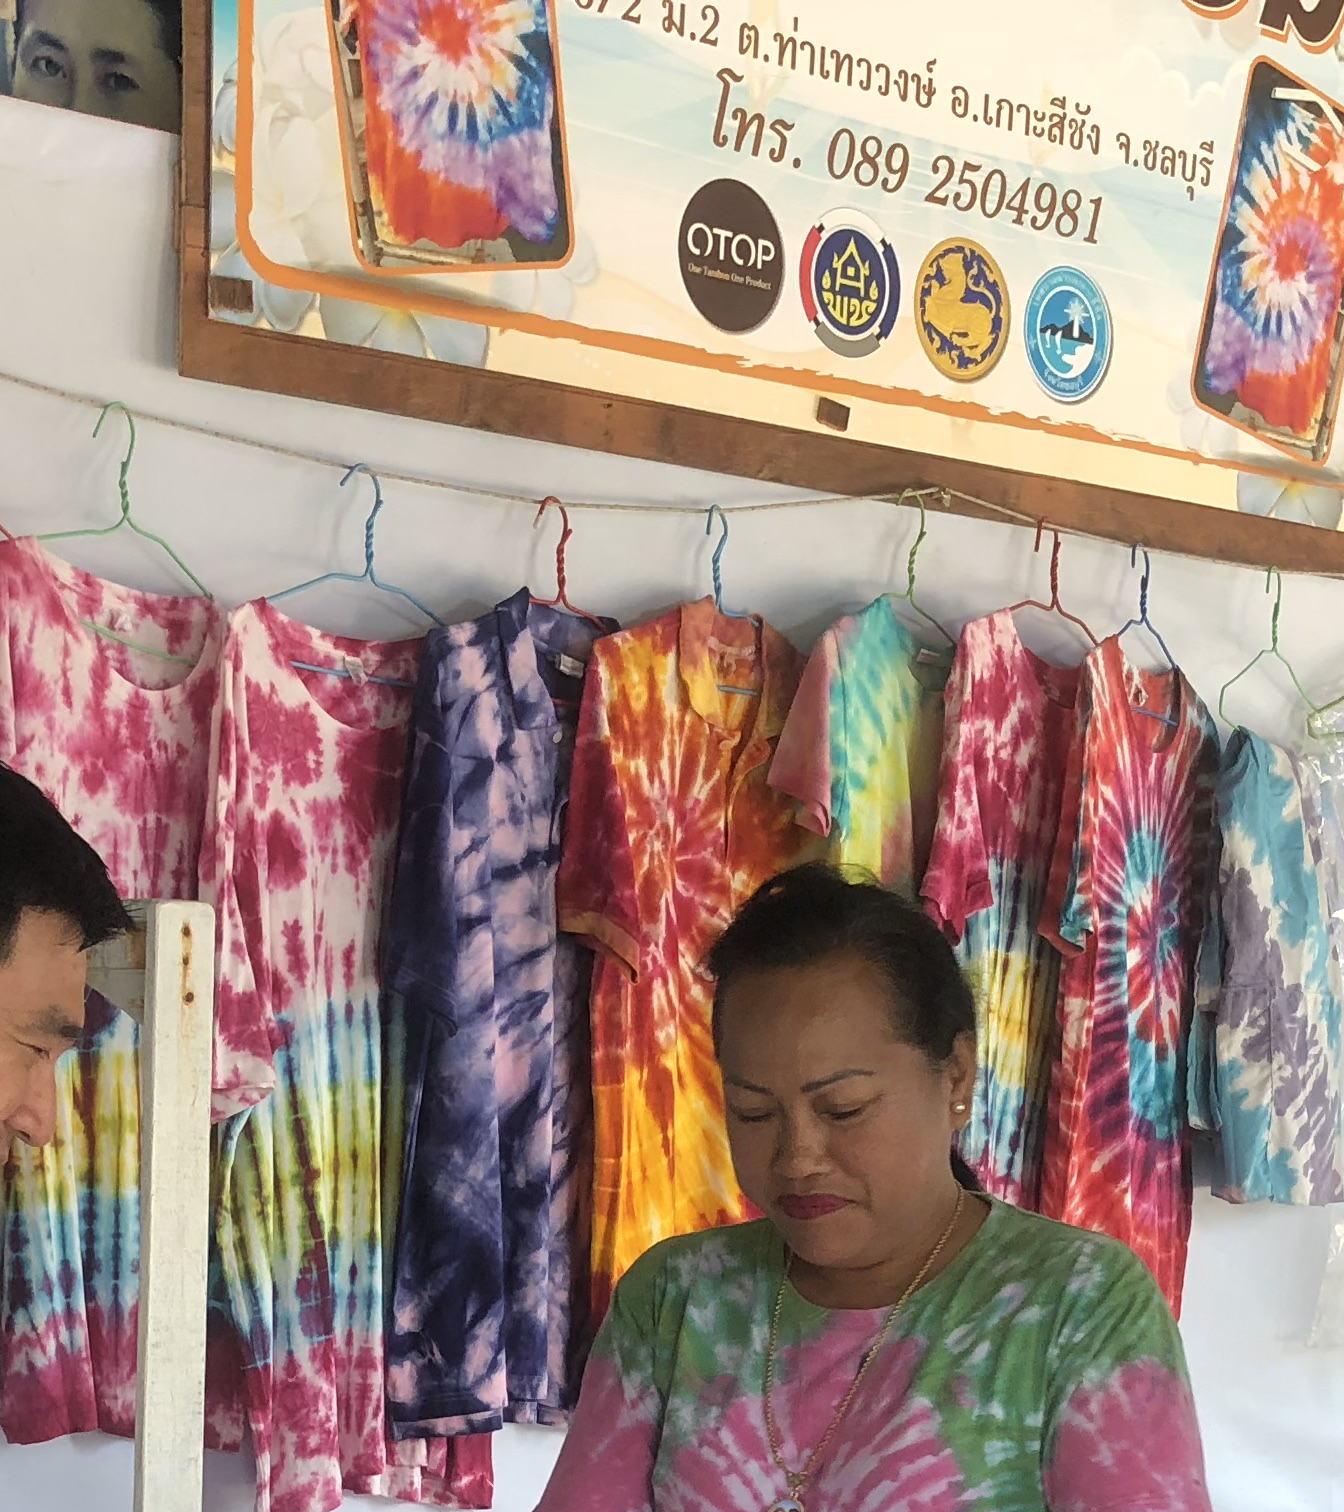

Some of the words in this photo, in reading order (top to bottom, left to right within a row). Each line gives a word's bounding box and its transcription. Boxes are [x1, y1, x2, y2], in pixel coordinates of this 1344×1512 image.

[712, 67, 802, 170] โทร.
[826, 127, 911, 194] 089
[924, 154, 1104, 246] 2504981
[738, 16, 938, 108] ต.ท่าเทววงษ์
[951, 85, 1102, 156] อ.เกาะสีชัง
[1115, 131, 1216, 202] จ.ชลบุรี
[686, 222, 775, 270] OTOP
